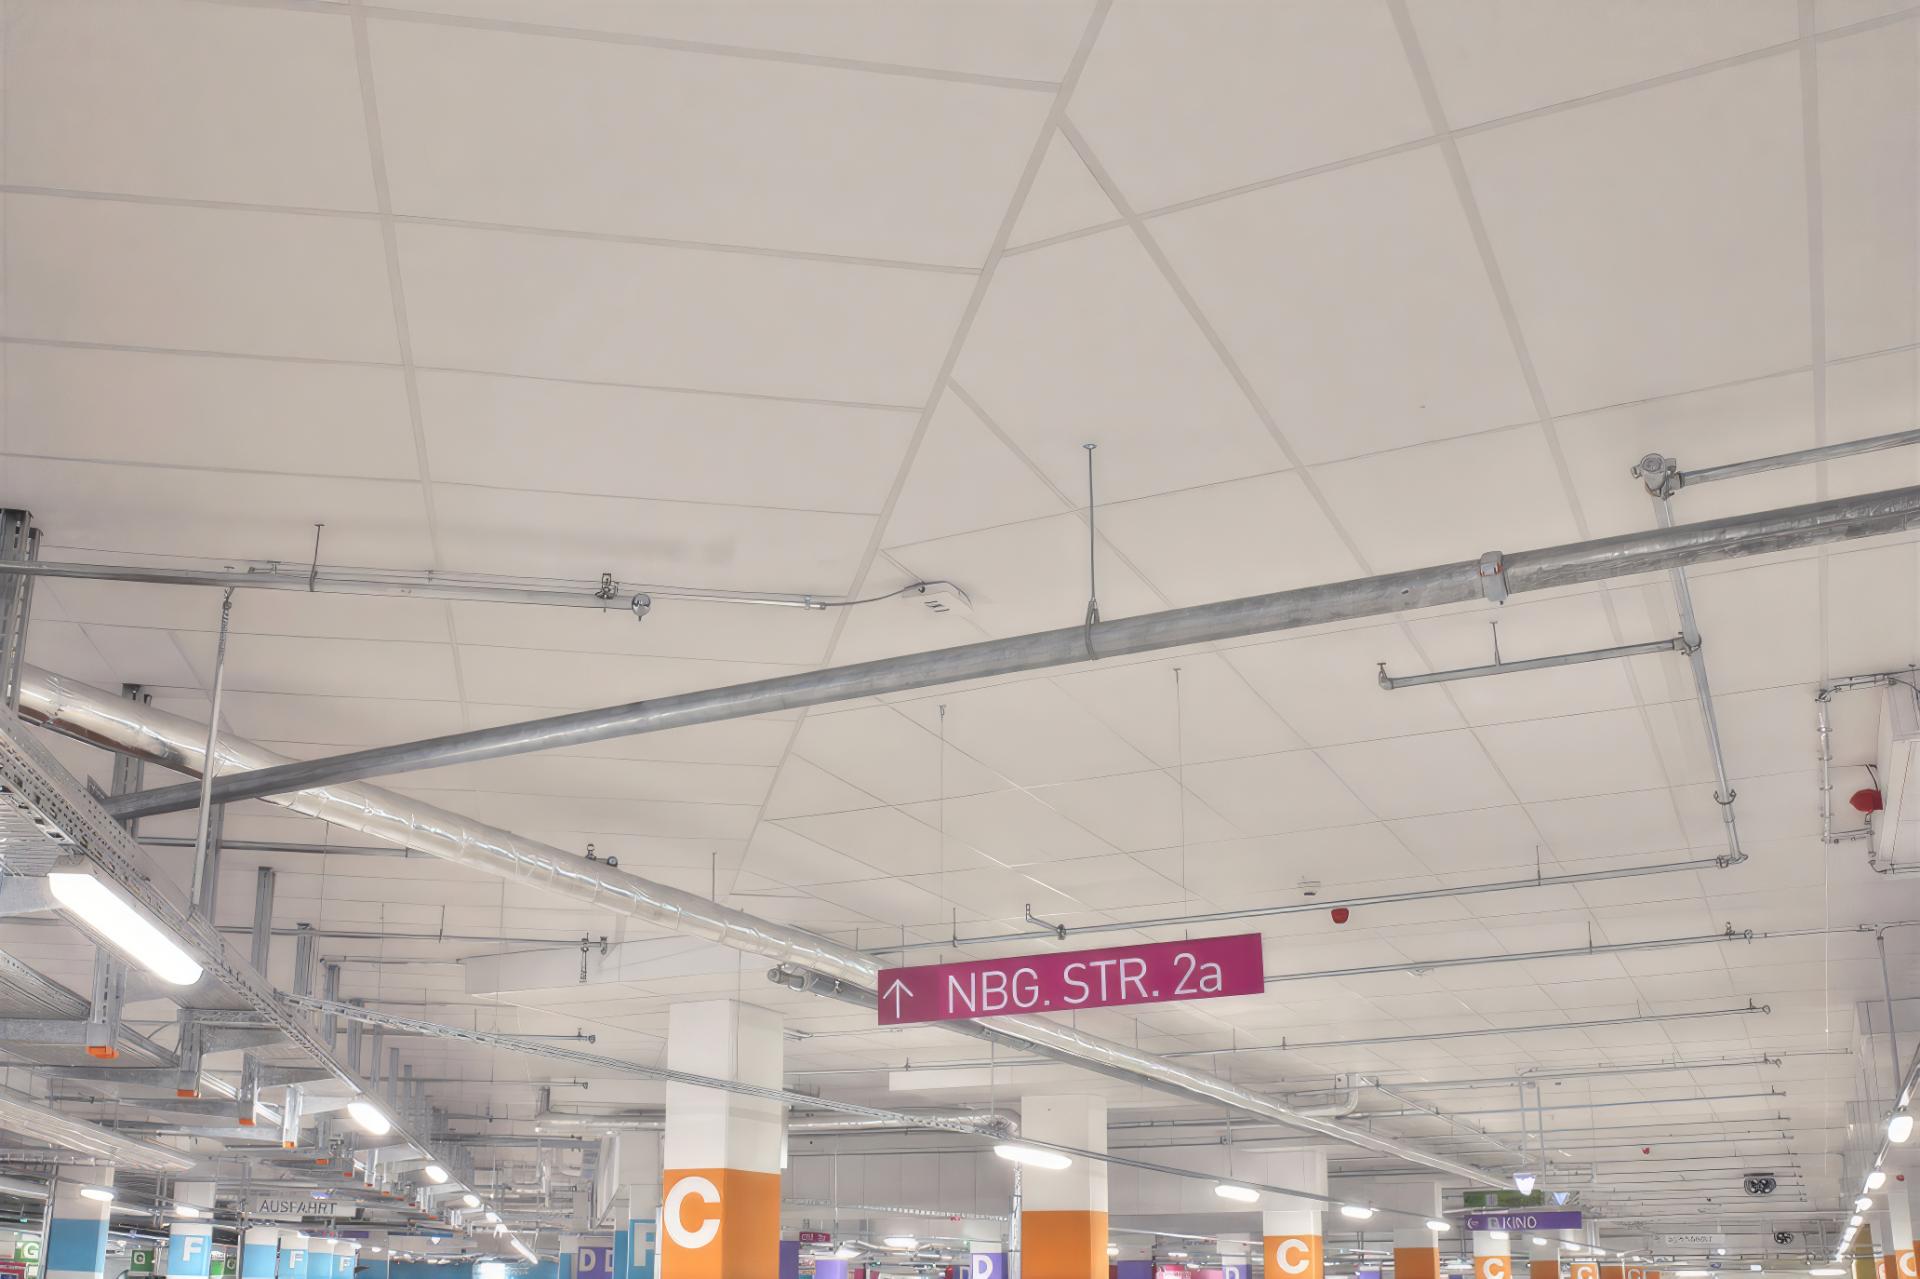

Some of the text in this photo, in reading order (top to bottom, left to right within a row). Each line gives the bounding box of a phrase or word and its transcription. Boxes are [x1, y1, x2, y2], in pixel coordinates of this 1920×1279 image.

[948, 952, 1223, 1014] NBG. STR. 2a
[259, 1199, 338, 1215] AUSFAHRT
[664, 1176, 721, 1249] C
[1502, 1215, 1537, 1229] KINO
[182, 1236, 204, 1262] F
[633, 1222, 657, 1267] F
[1276, 1238, 1310, 1275] C
[289, 1250, 305, 1269] F
[579, 1248, 597, 1272] D
[1482, 1257, 1505, 1279] C
